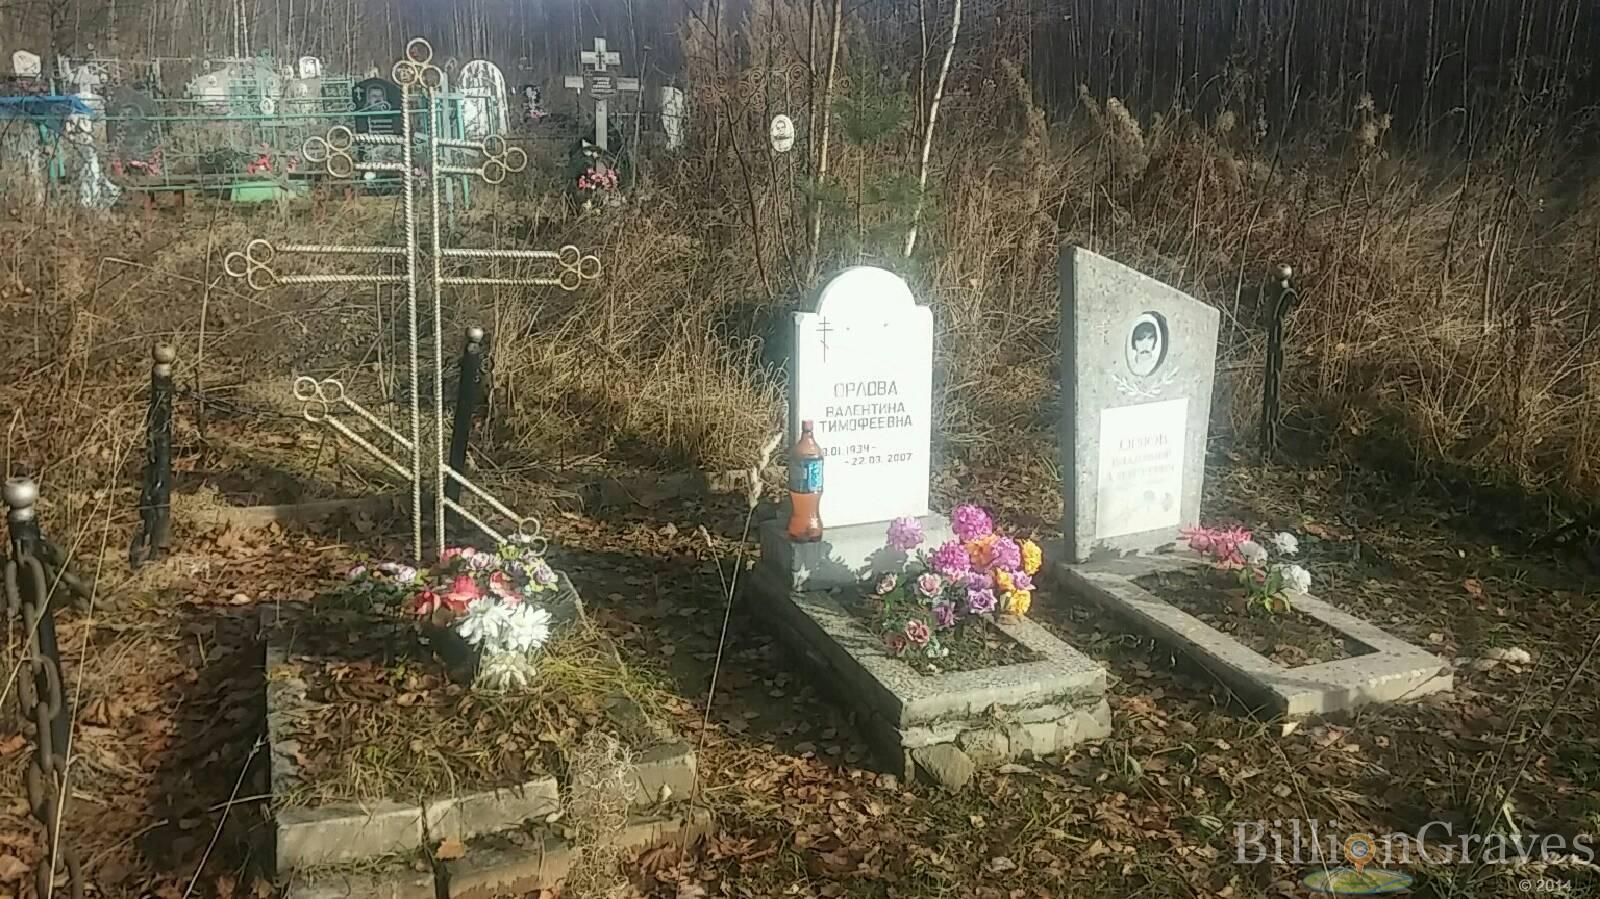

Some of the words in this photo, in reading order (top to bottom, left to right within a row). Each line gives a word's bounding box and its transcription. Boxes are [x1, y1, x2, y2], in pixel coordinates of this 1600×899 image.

[833, 380, 898, 397] ОРЛОВА
[825, 401, 905, 418] ВАЛЕНТИНА
[818, 414, 912, 434] ТИМОФЕЕВНА
